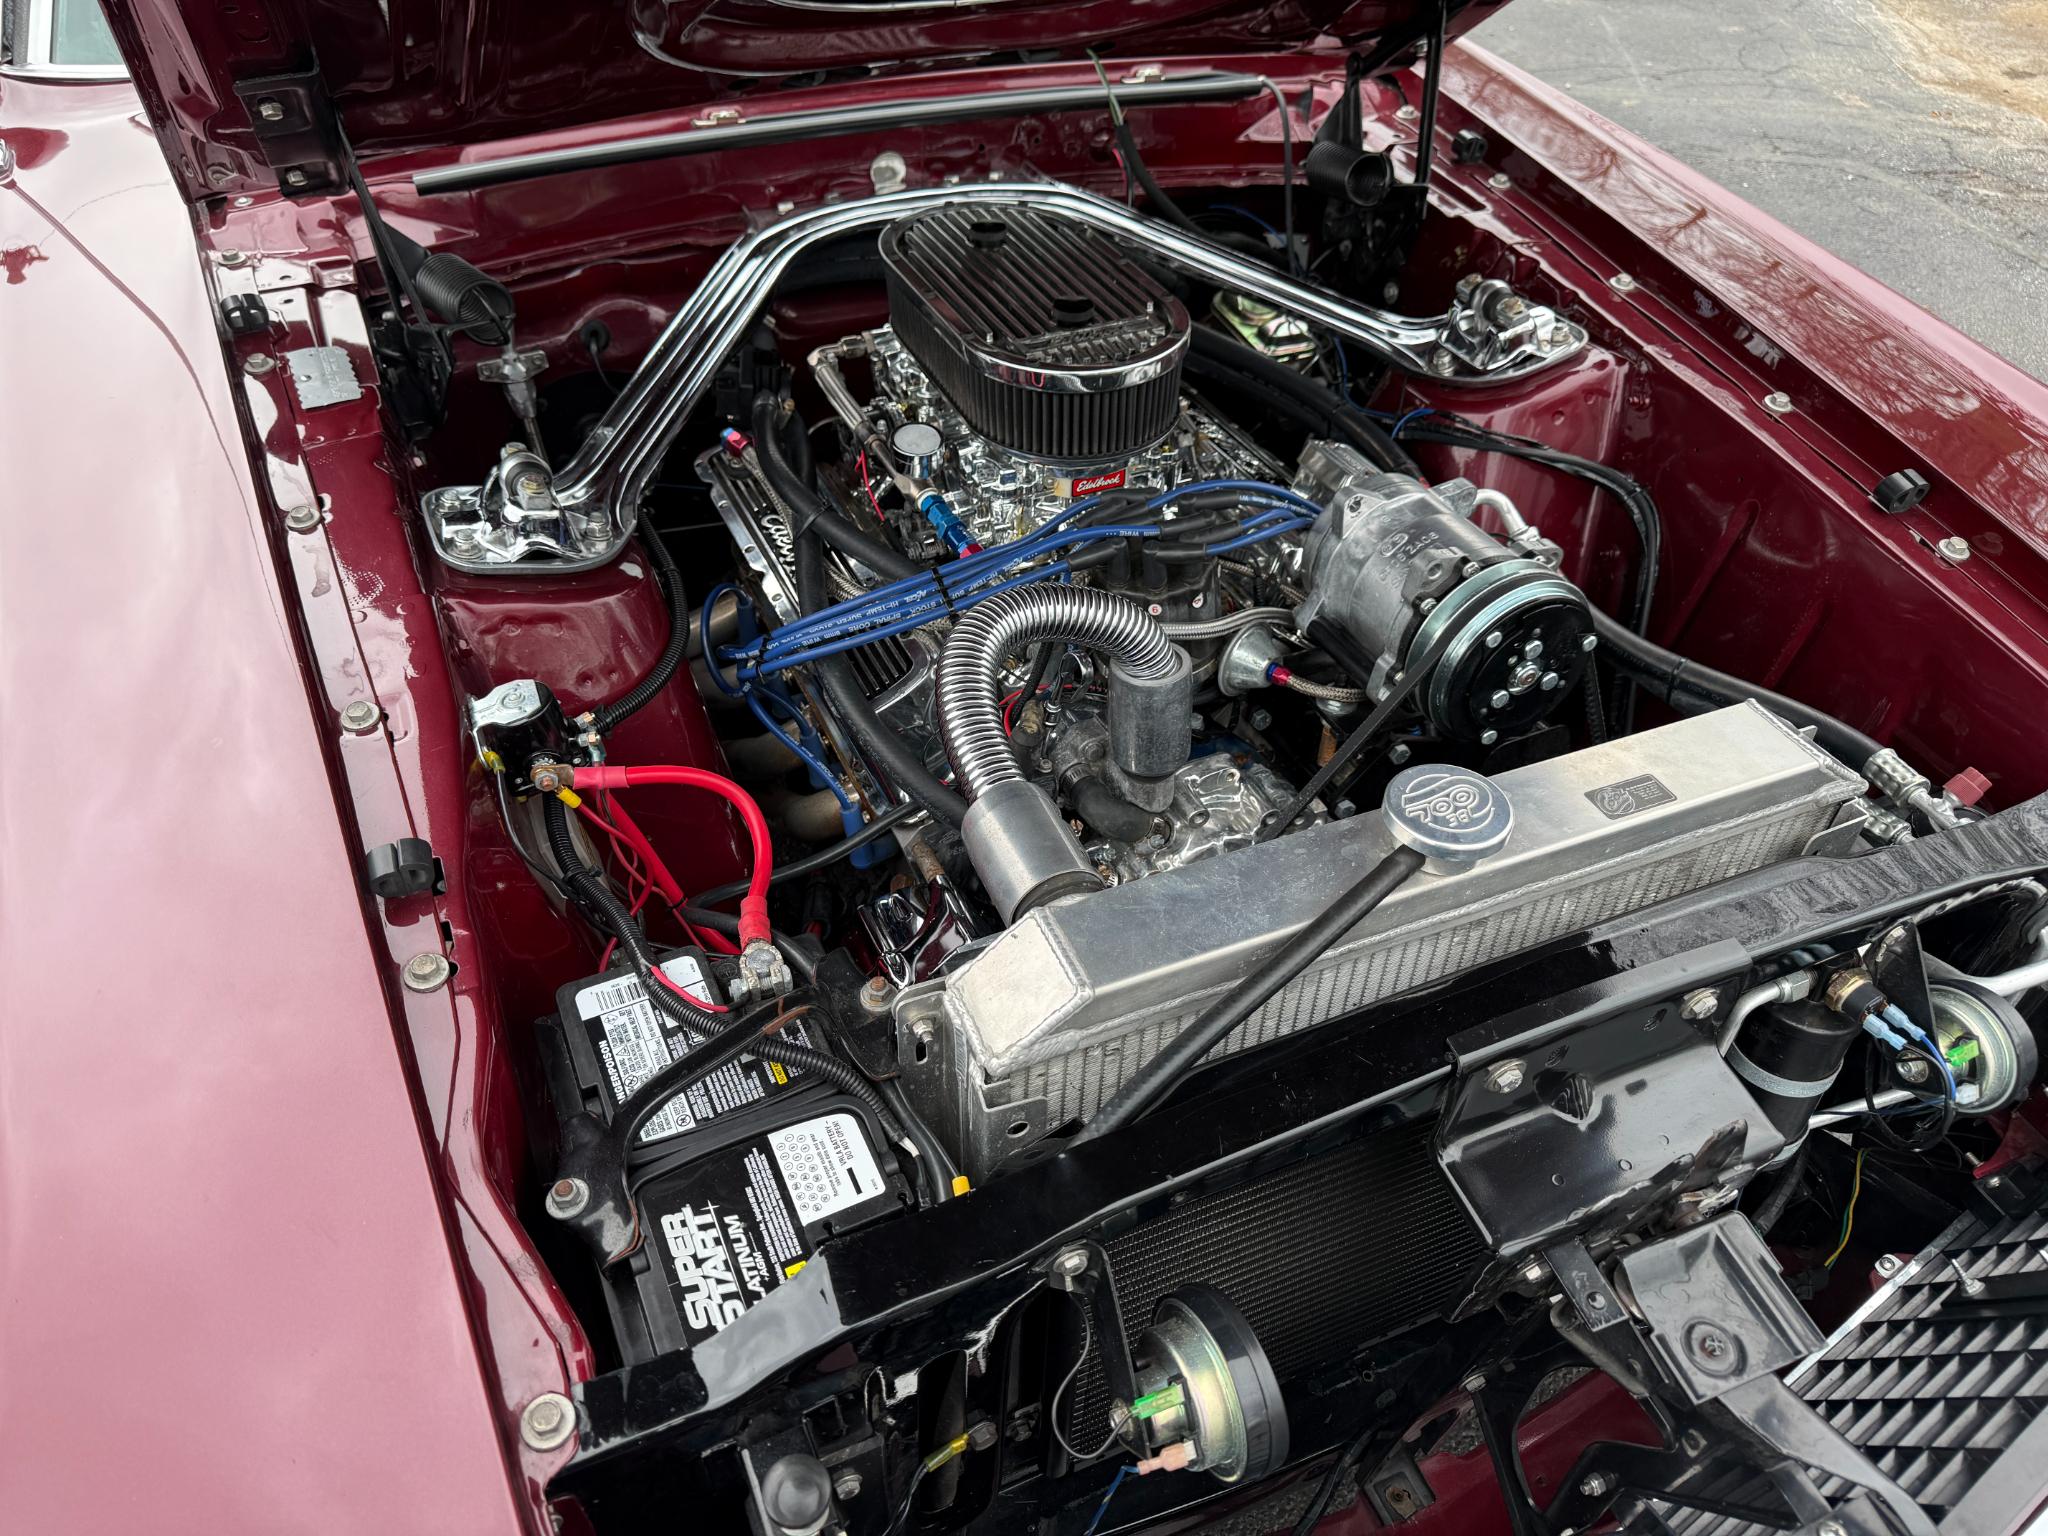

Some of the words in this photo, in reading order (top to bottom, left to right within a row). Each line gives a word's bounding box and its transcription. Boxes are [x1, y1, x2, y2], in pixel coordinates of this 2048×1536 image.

[1076, 474, 1121, 492] Edelbrock
[824, 1124, 840, 1150] BATTERY
[831, 1119, 844, 1138] OPEN!
[839, 1137, 849, 1150] NOT
[835, 1149, 847, 1166] VRLA
[844, 1149, 854, 1160] DO
[682, 1203, 748, 1332] START
[723, 1214, 767, 1305] LATINUM
[660, 1211, 718, 1330] SUPER
